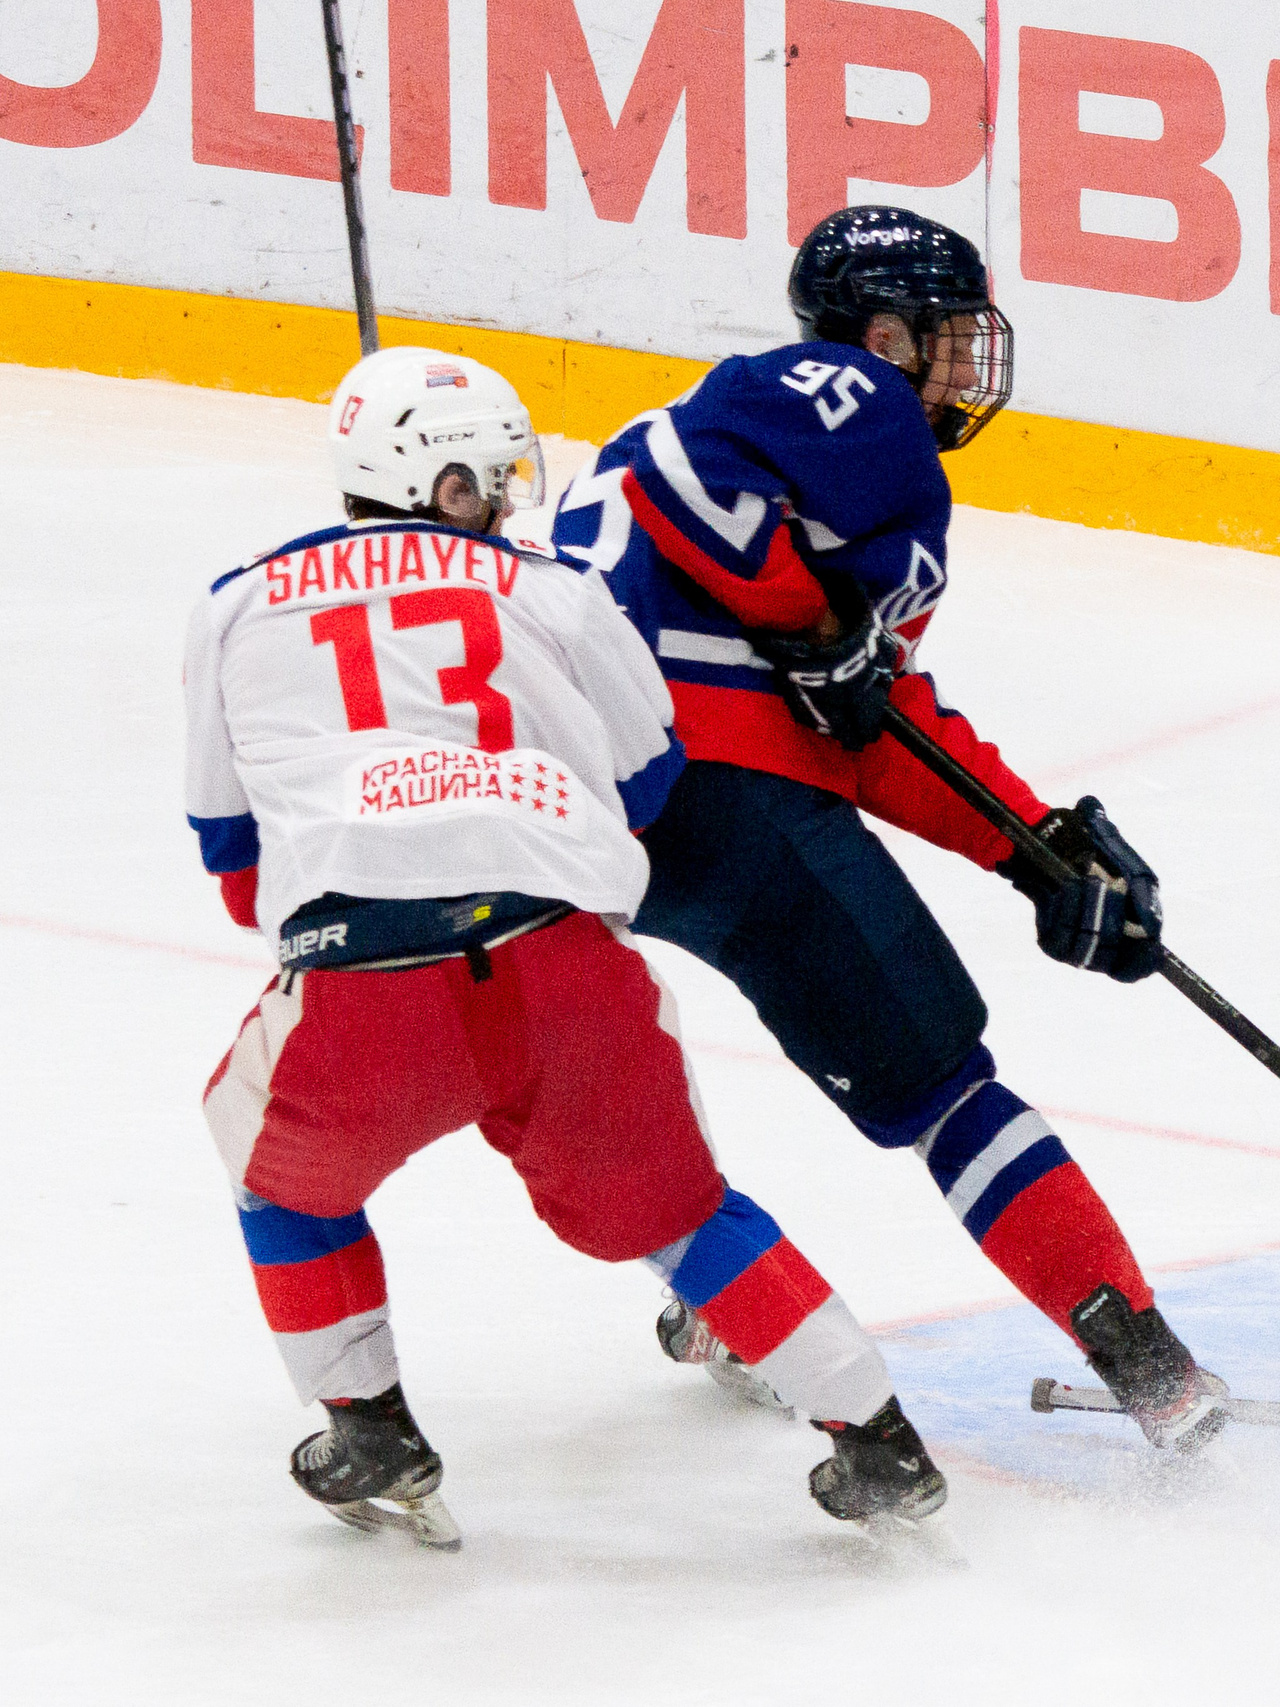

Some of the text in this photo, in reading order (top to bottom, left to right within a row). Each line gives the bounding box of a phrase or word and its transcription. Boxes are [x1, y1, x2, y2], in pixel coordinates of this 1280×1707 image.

[780, 360, 876, 431] 95
[433, 431, 475, 444] CCM
[266, 533, 520, 606] SAKHAYEV
[310, 587, 515, 754] 13
[359, 773, 503, 815] МАШИНА
[362, 750, 501, 791] КРАСНАЯ
